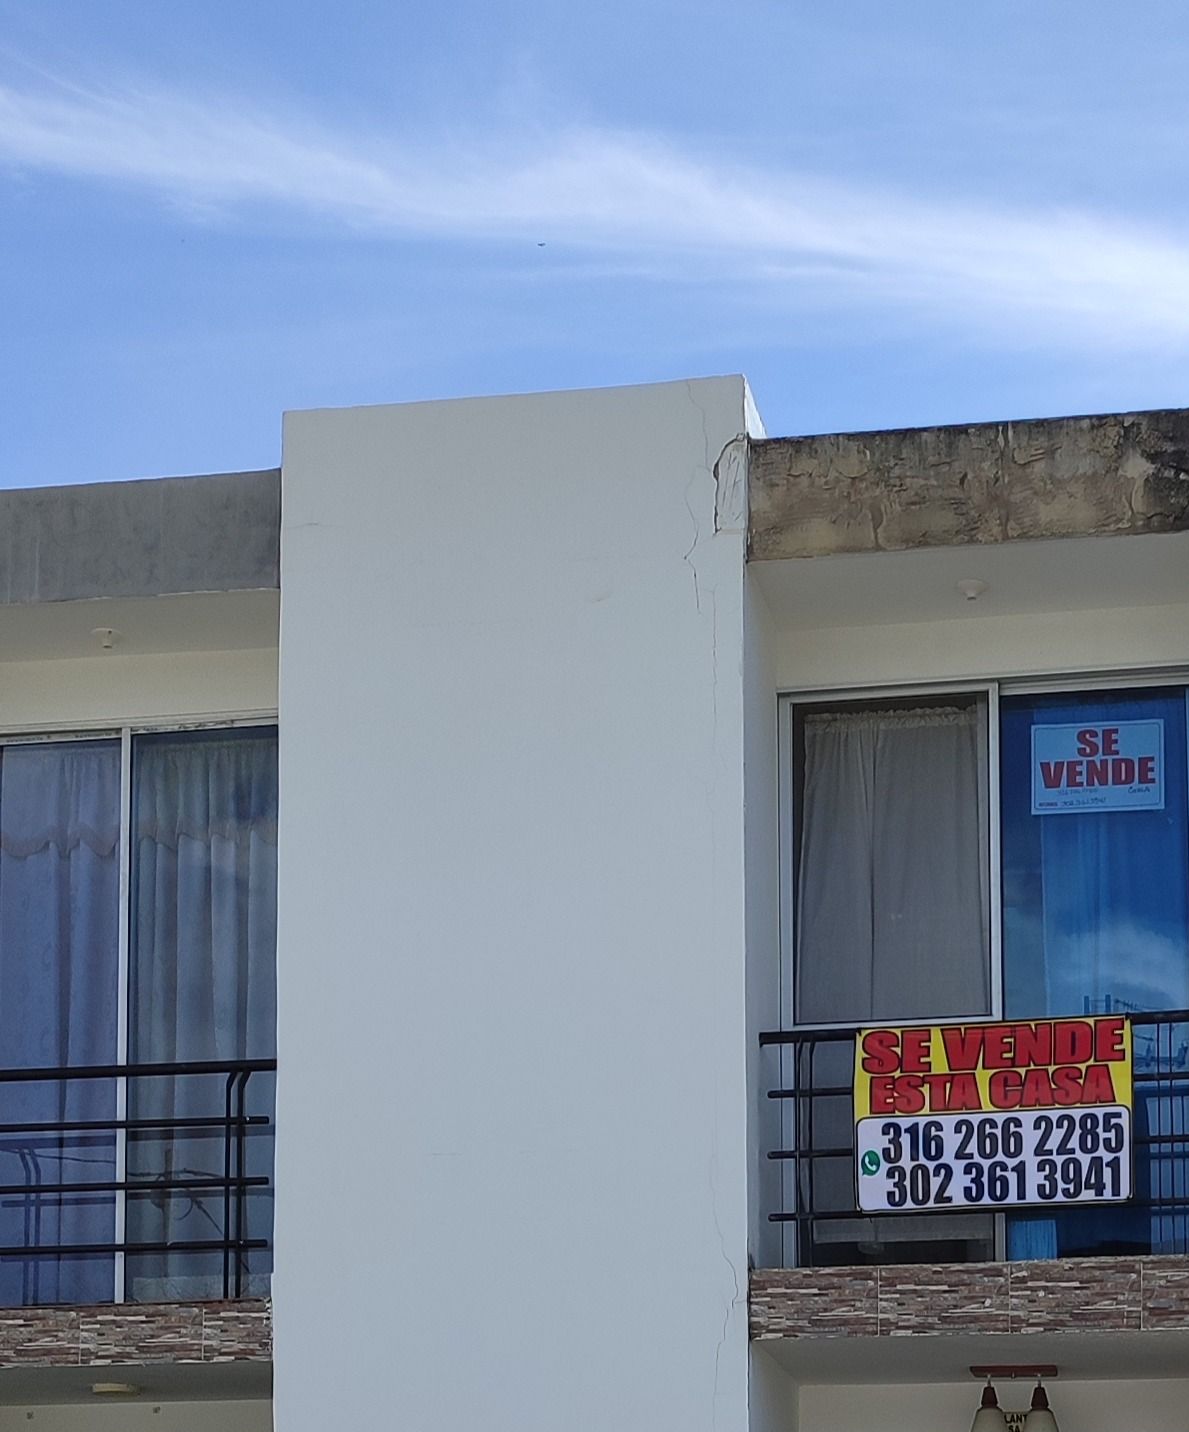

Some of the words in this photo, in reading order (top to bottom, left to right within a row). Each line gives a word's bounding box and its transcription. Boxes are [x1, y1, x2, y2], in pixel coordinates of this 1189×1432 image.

[1076, 728, 1120, 758] SE
[1040, 756, 1156, 789] VENDE
[862, 1029, 932, 1075] SE
[940, 1018, 1126, 1072] VENDE
[869, 1072, 982, 1115] ESTA
[988, 1063, 1117, 1109] CASA
[881, 1120, 944, 1164] 316
[953, 1116, 1023, 1161] 266
[1032, 1111, 1125, 1158] 2285
[885, 1162, 954, 1208] 302
[962, 1159, 1027, 1203] 361
[1036, 1155, 1122, 1200] 3941
